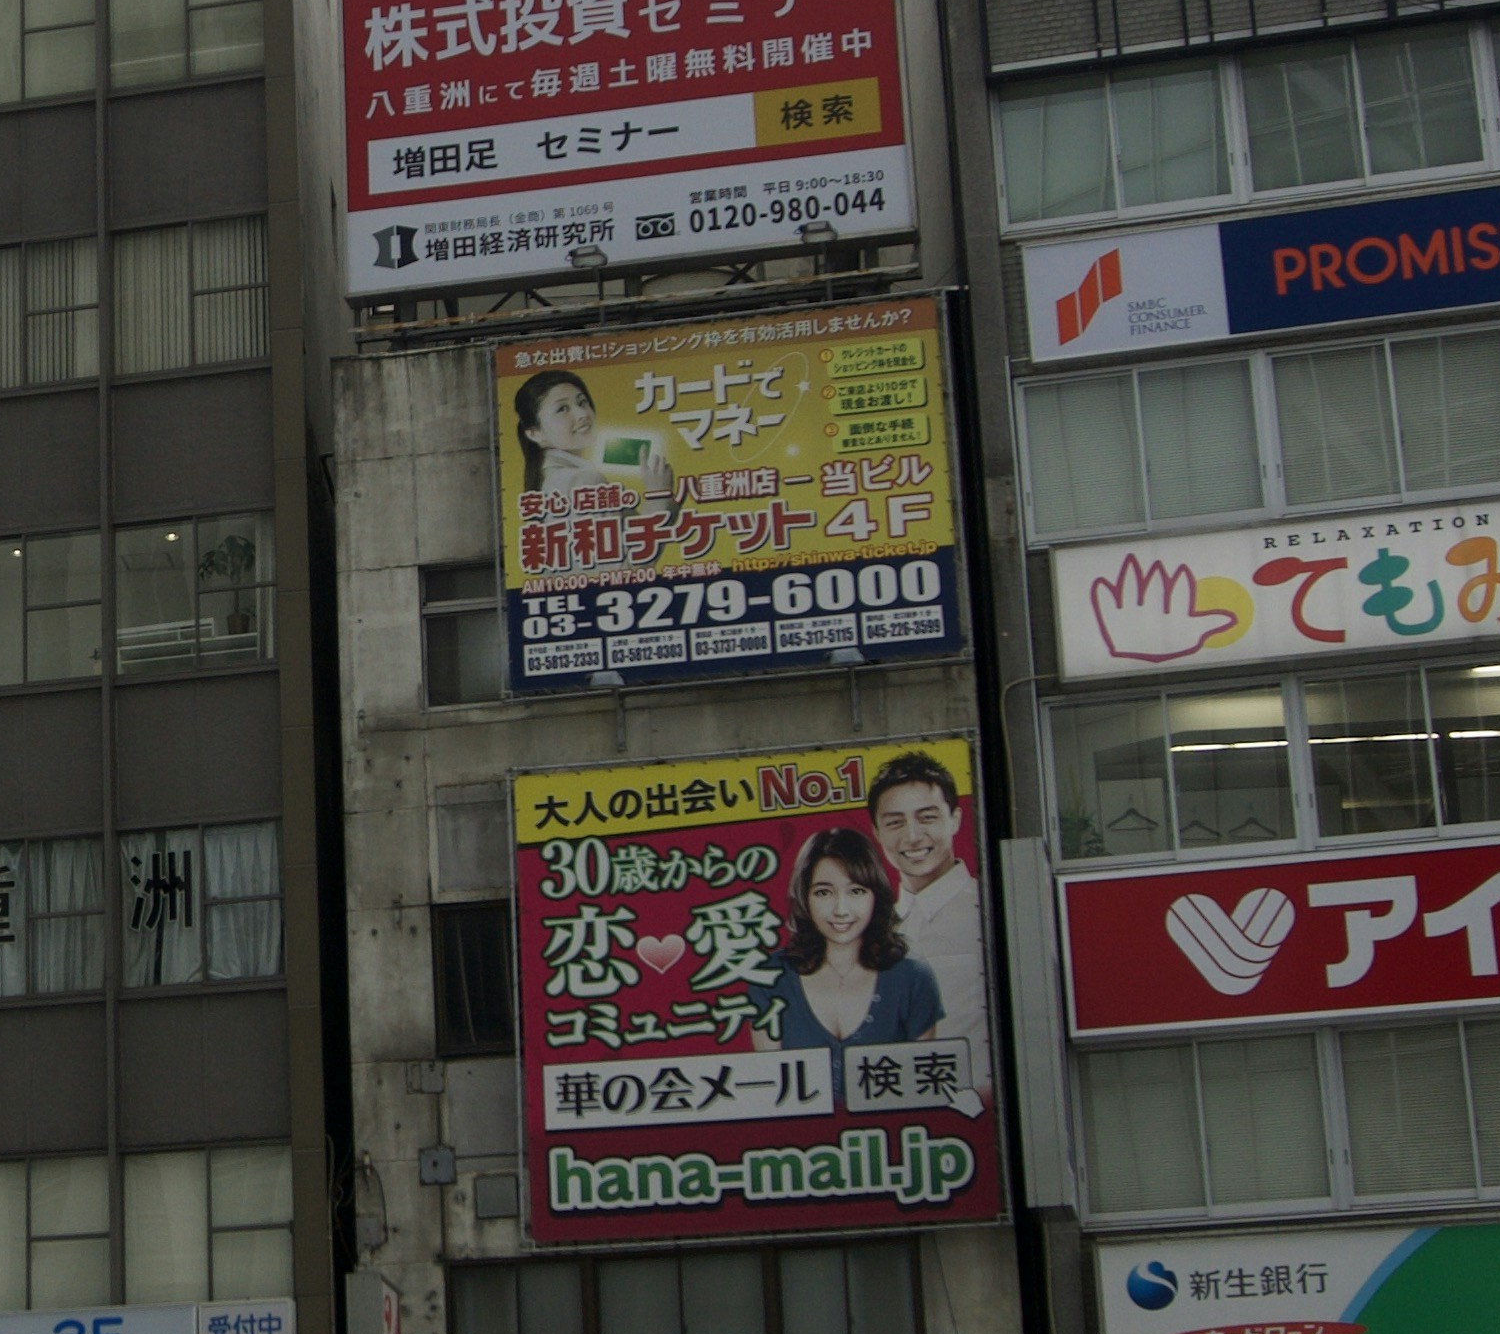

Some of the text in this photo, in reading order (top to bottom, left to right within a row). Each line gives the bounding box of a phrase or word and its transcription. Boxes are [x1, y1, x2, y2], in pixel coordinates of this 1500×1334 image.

[365, 28, 874, 120] 八重洲にて毎週土曜無料開催中
[392, 93, 855, 181] 増田足 セミナー 検索
[689, 179, 792, 206] 営業時間 平日
[689, 186, 886, 235] 0120-980-044
[425, 219, 615, 262] 増田経済研究所
[1128, 295, 1167, 313] SMBC
[1128, 303, 1207, 325] CONSUMER
[1129, 318, 1193, 336] FINANCE
[634, 359, 785, 414] カードで
[669, 407, 786, 450] マネー
[674, 456, 933, 503] 八重洲店 当ビル
[521, 494, 933, 573] 新和チケット 4F
[1263, 512, 1490, 549] RELAXATION
[522, 593, 586, 616] TEL
[539, 836, 780, 900] 30歳からの
[546, 994, 790, 1049] コミュニティ
[556, 1052, 958, 1118] 華の会メール 検索
[550, 1127, 975, 1212] hana-mail.jp
[1189, 1262, 1328, 1302] 新生銀行
